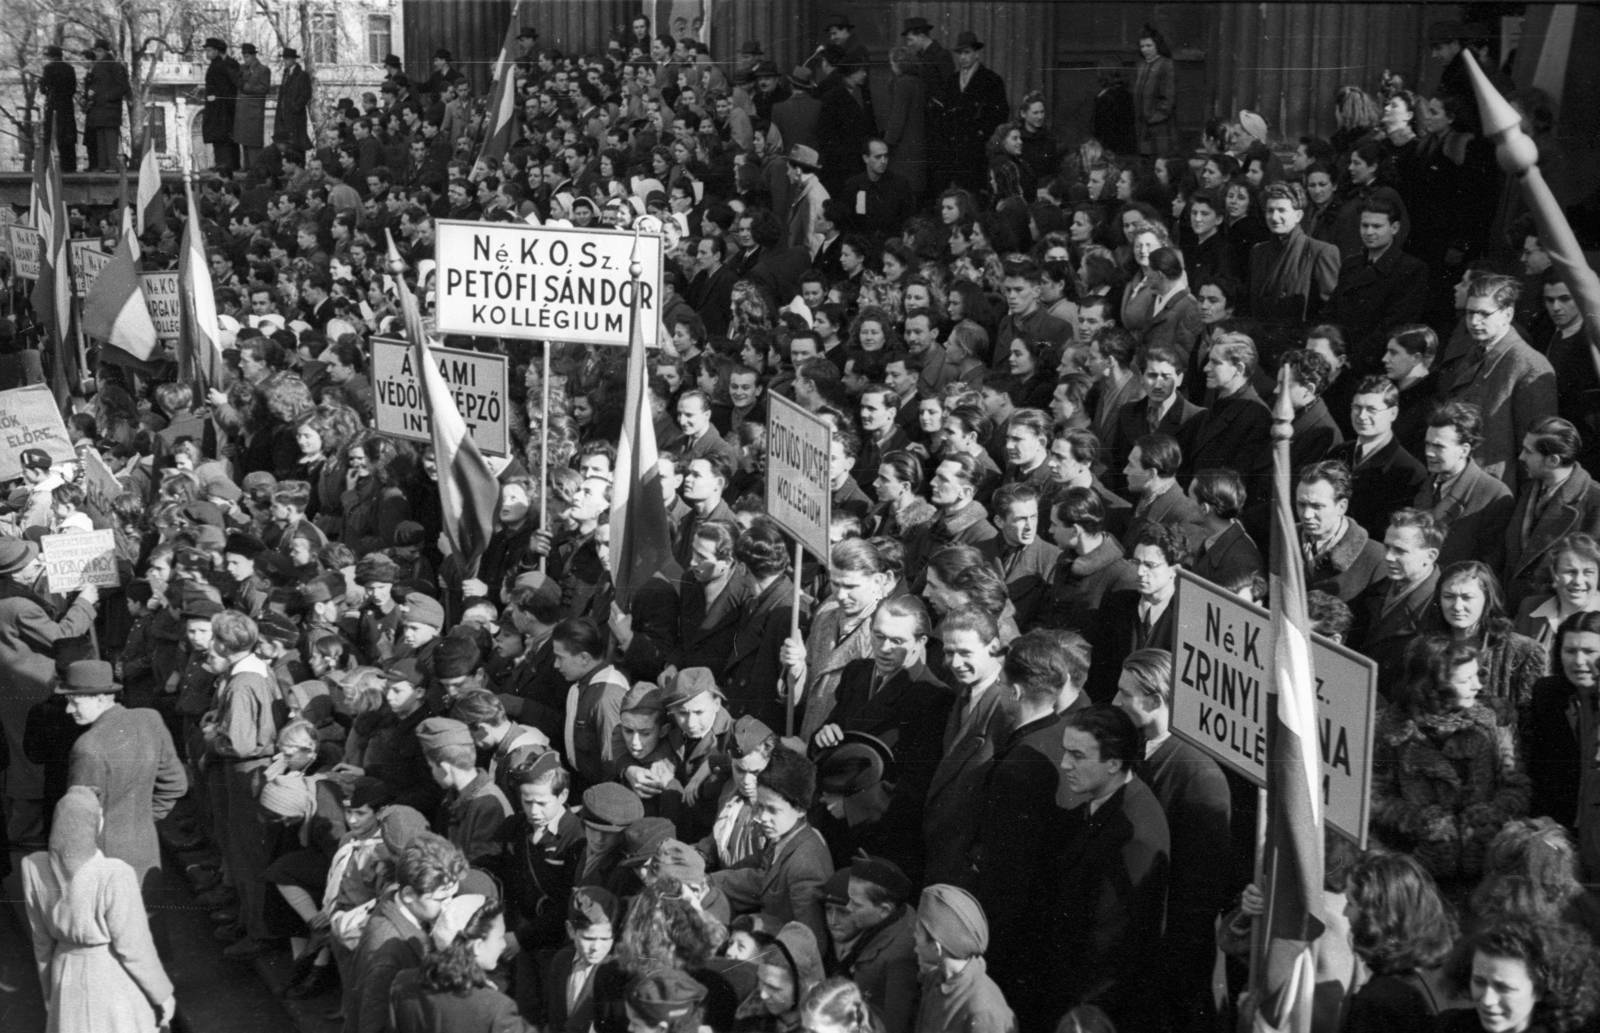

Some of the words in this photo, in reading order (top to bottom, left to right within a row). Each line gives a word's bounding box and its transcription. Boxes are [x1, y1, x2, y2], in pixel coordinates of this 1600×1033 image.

[474, 234, 619, 270] Né.K.O.Sz.
[447, 264, 536, 301] PETŐFI
[543, 269, 653, 310] SÁNDOR
[147, 299, 170, 317] ARGA
[472, 303, 623, 333] KOLLÉGIUM
[401, 347, 475, 387] ÁAMI
[0, 409, 21, 430] ŐK
[770, 415, 800, 471] EÖTVÖS
[802, 432, 829, 491] JÓZSEF
[777, 474, 821, 528] KOLLÉGIUM
[1181, 641, 1259, 724] ZRINYI
